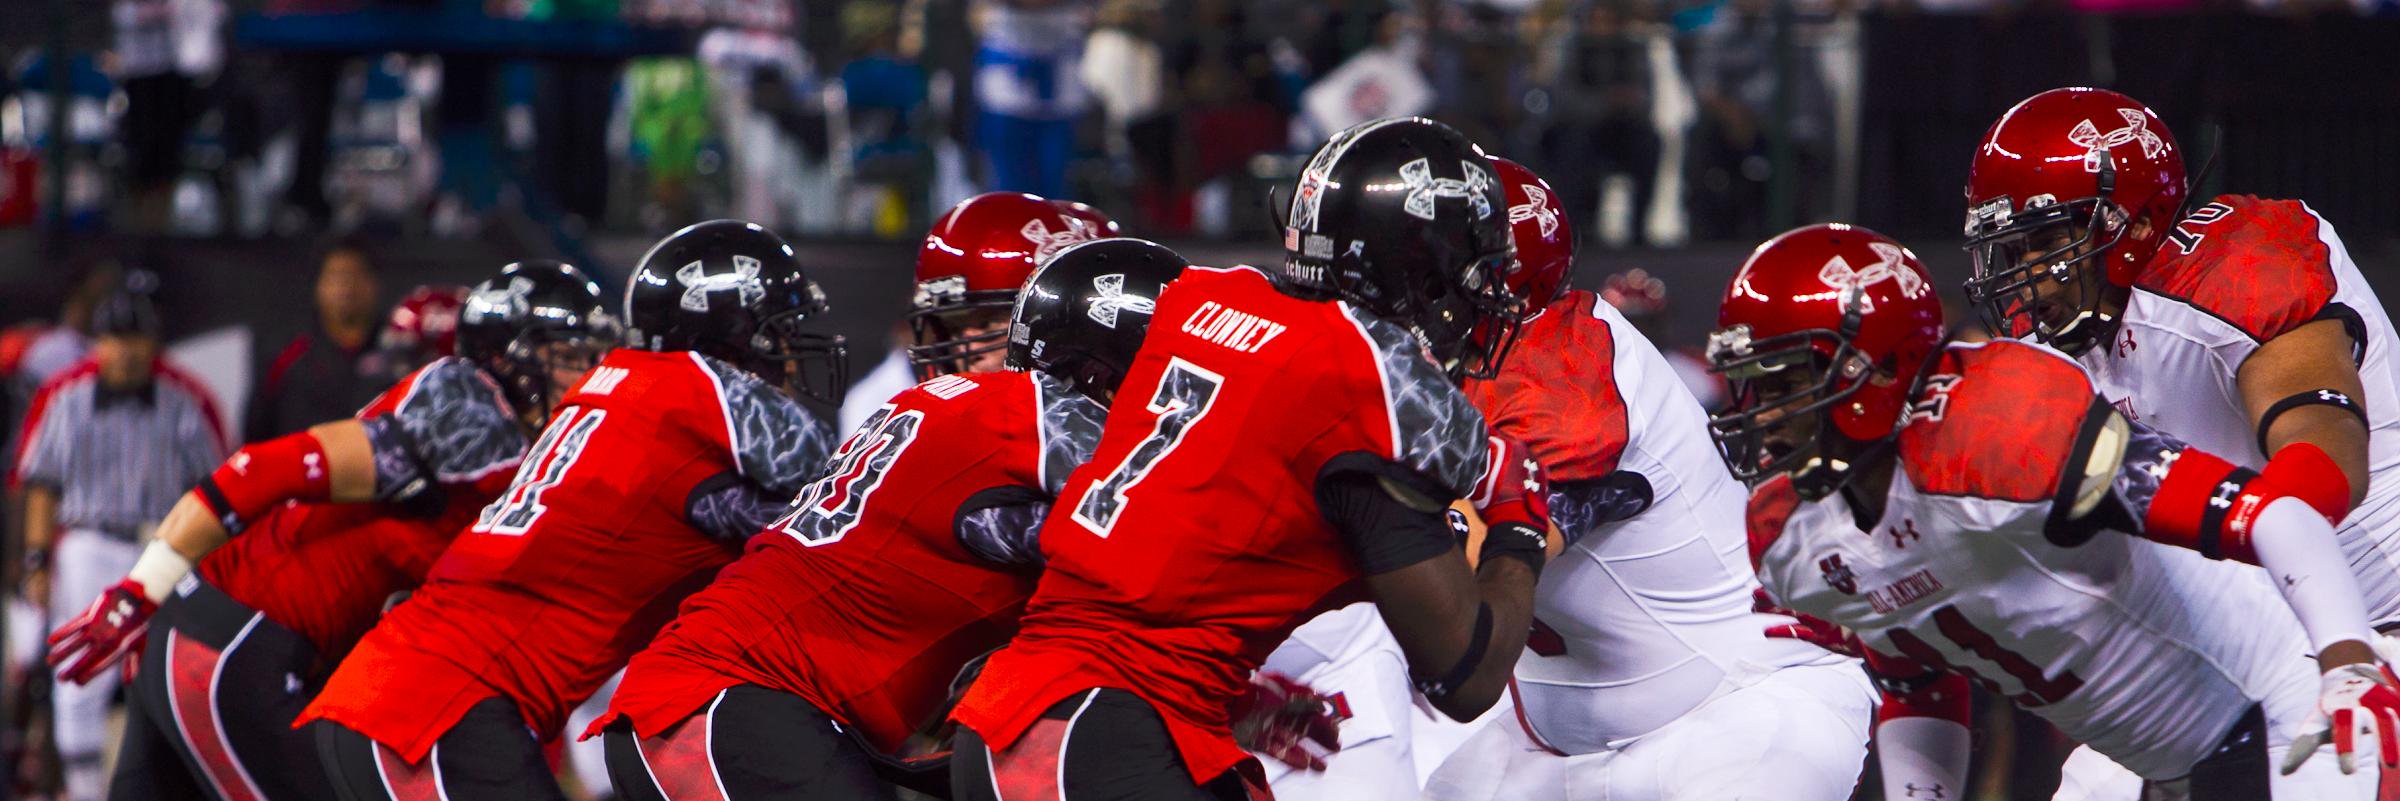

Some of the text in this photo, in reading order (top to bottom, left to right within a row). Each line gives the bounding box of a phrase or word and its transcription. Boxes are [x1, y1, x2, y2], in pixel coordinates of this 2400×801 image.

[1285, 259, 1325, 282] schutt
[1181, 300, 1288, 353] CLOWNEY
[1070, 355, 1225, 539] 7
